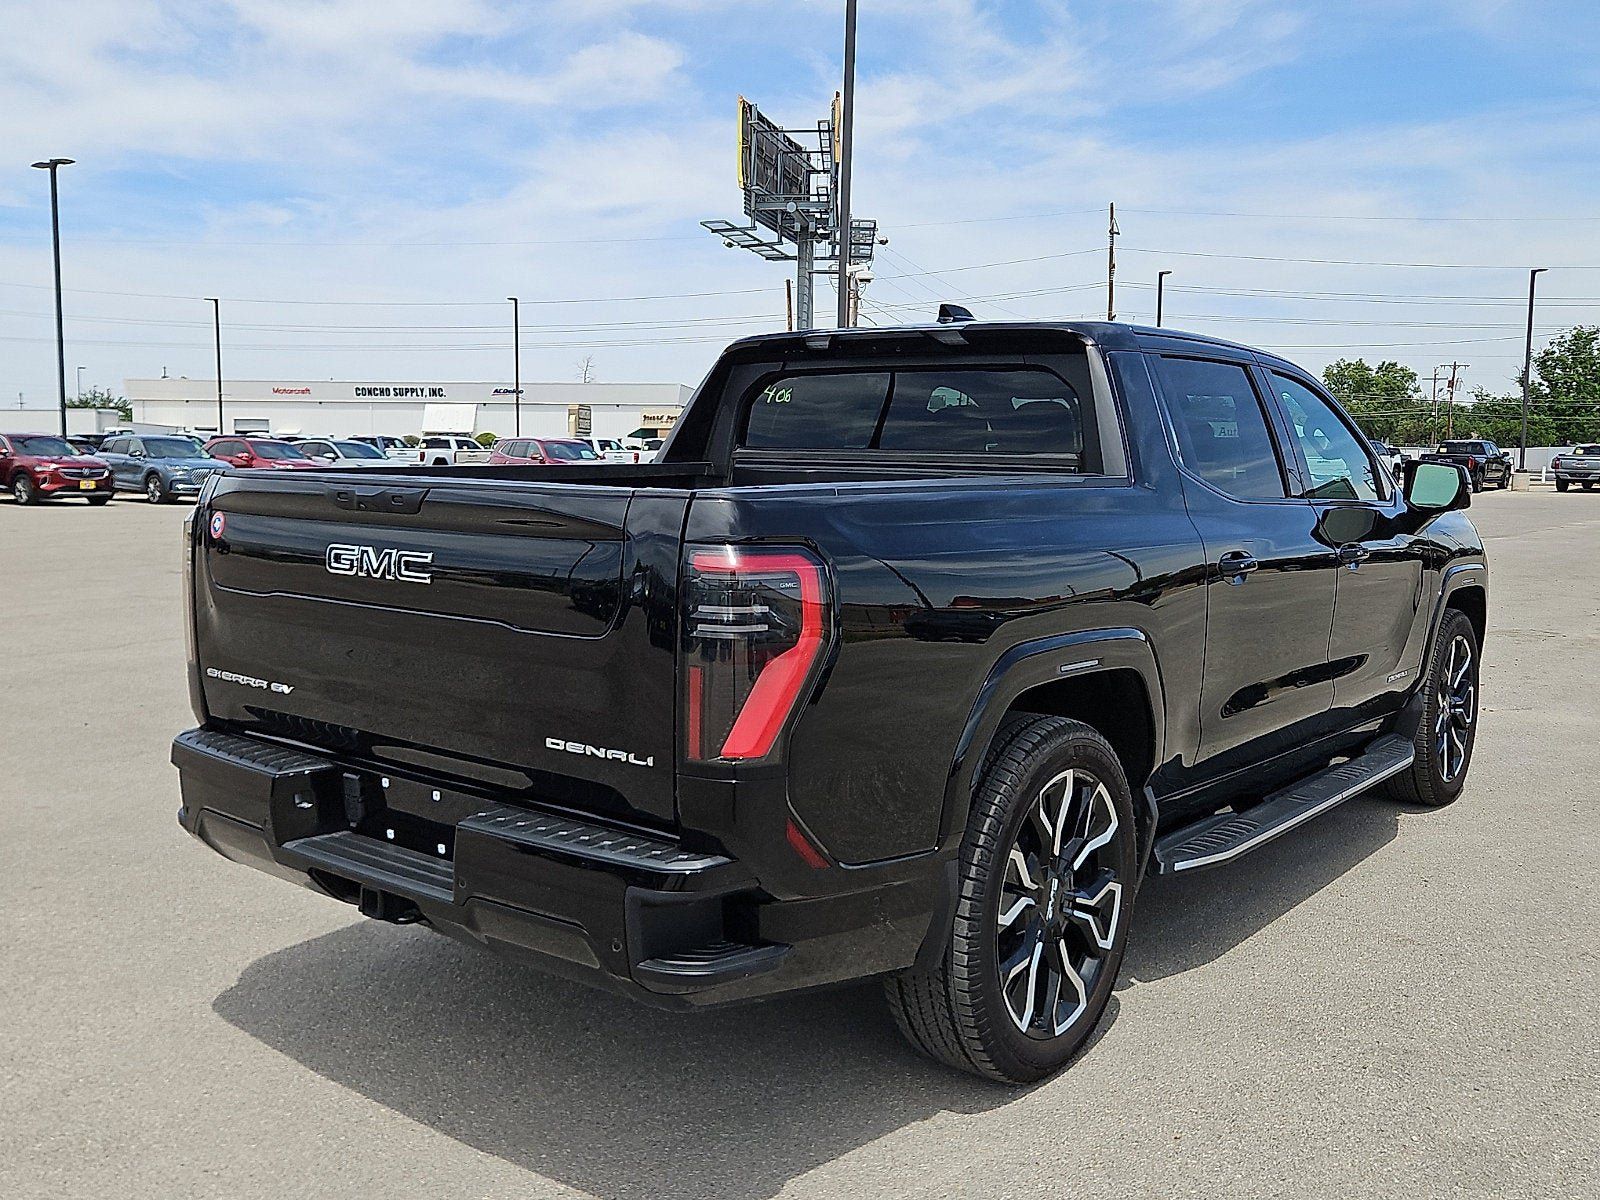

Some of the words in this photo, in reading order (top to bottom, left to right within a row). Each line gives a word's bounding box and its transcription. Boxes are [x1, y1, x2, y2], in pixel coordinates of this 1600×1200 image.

[354, 386, 391, 397] CONCHO
[392, 387, 428, 398] SUPPLY,
[428, 387, 447, 398] INC.
[325, 543, 434, 585] GMC
[206, 667, 269, 690] SIERRA
[270, 681, 295, 695] EV
[545, 737, 654, 767] DENALI
